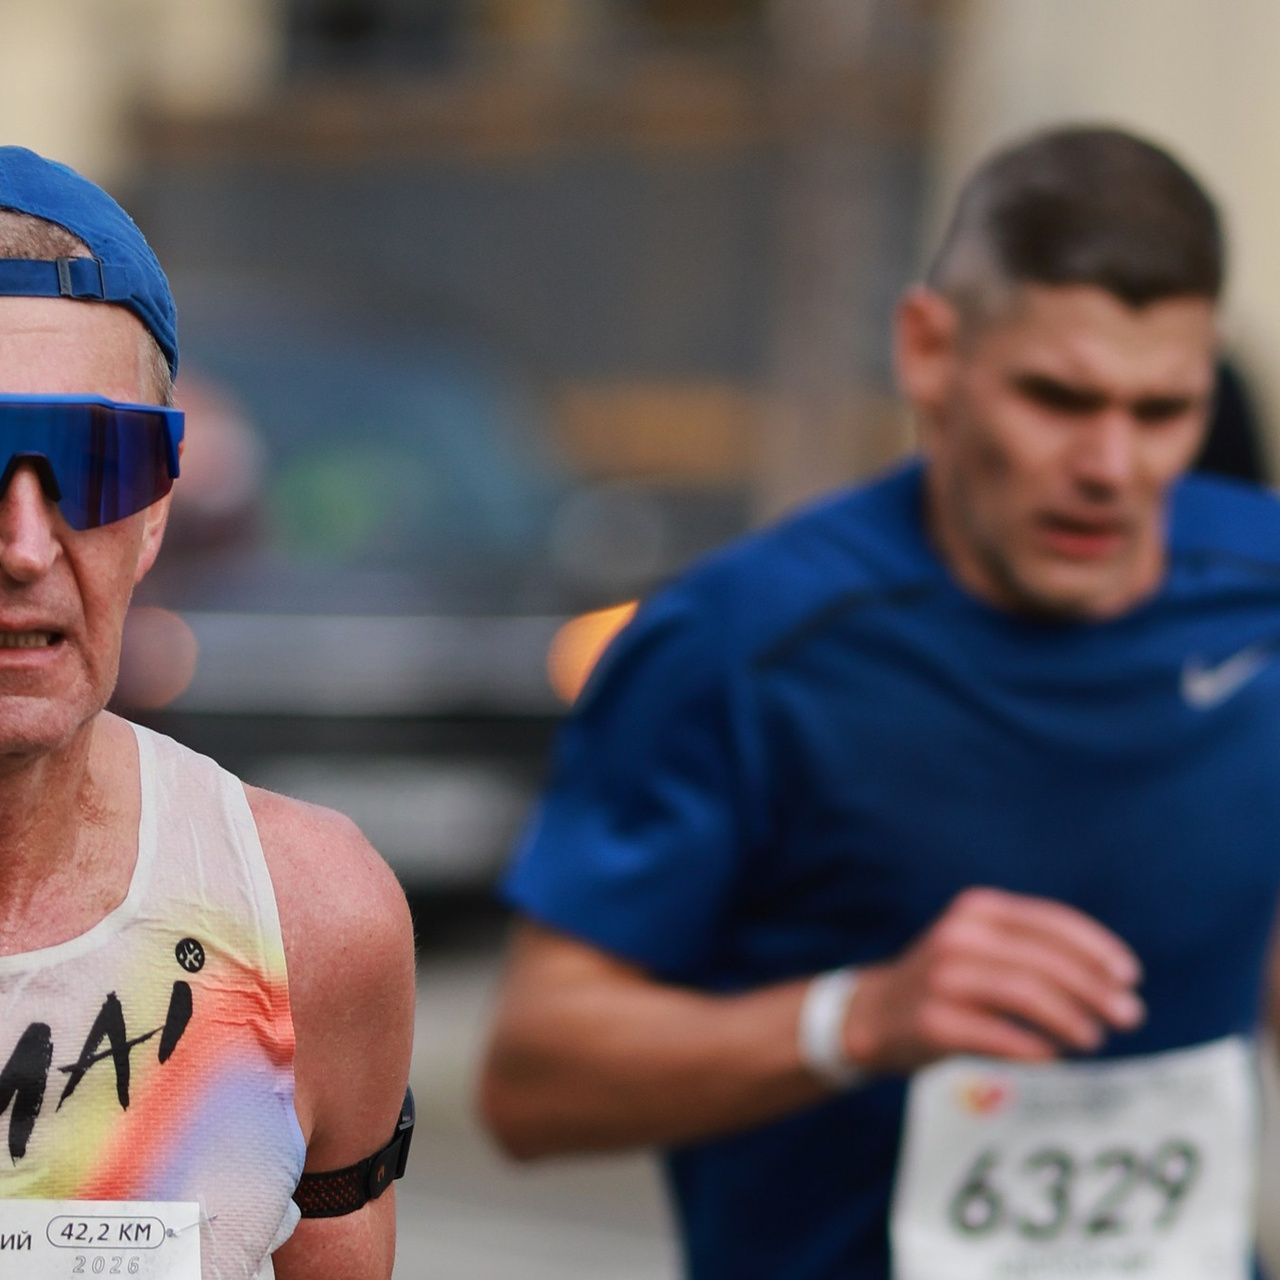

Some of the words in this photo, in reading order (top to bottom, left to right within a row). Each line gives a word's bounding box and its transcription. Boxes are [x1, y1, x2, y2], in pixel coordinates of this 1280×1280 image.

[948, 1138, 1202, 1241] 6329
[60, 1222, 110, 1243] 42,2
[118, 1223, 152, 1242] КМ
[72, 1254, 140, 1274] 2026
